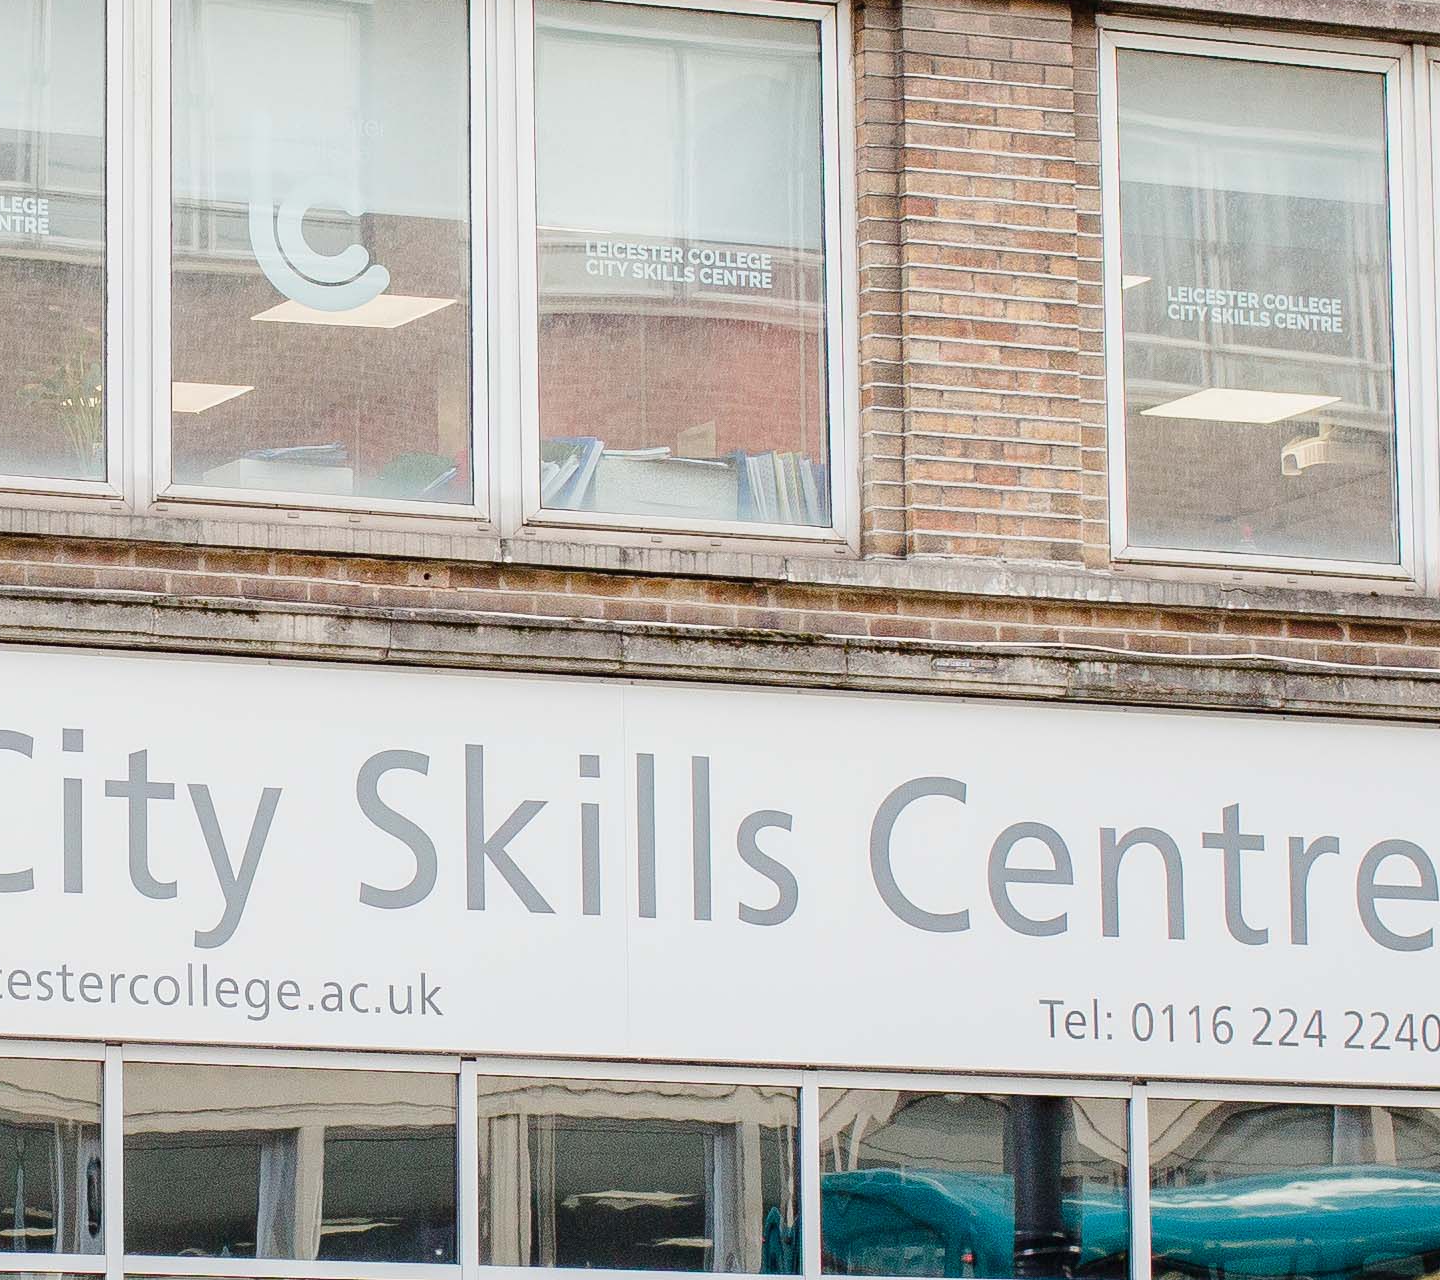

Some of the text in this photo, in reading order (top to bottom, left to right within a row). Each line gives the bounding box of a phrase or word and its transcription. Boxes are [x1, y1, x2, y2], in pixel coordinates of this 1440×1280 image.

[585, 240, 772, 270] LEICESTER COLLEGE
[586, 259, 772, 288] CITY SKILLS CENTRE
[1168, 286, 1341, 315] LEICESTER COLLEGE
[1168, 305, 1343, 333] CITY SKILLS CENTRE
[355, 743, 800, 926] Skills
[869, 777, 1439, 952] Centre
[1039, 998, 1113, 1041] Tel:
[1130, 1002, 1232, 1045] 0116
[1251, 1007, 1327, 1049] 224
